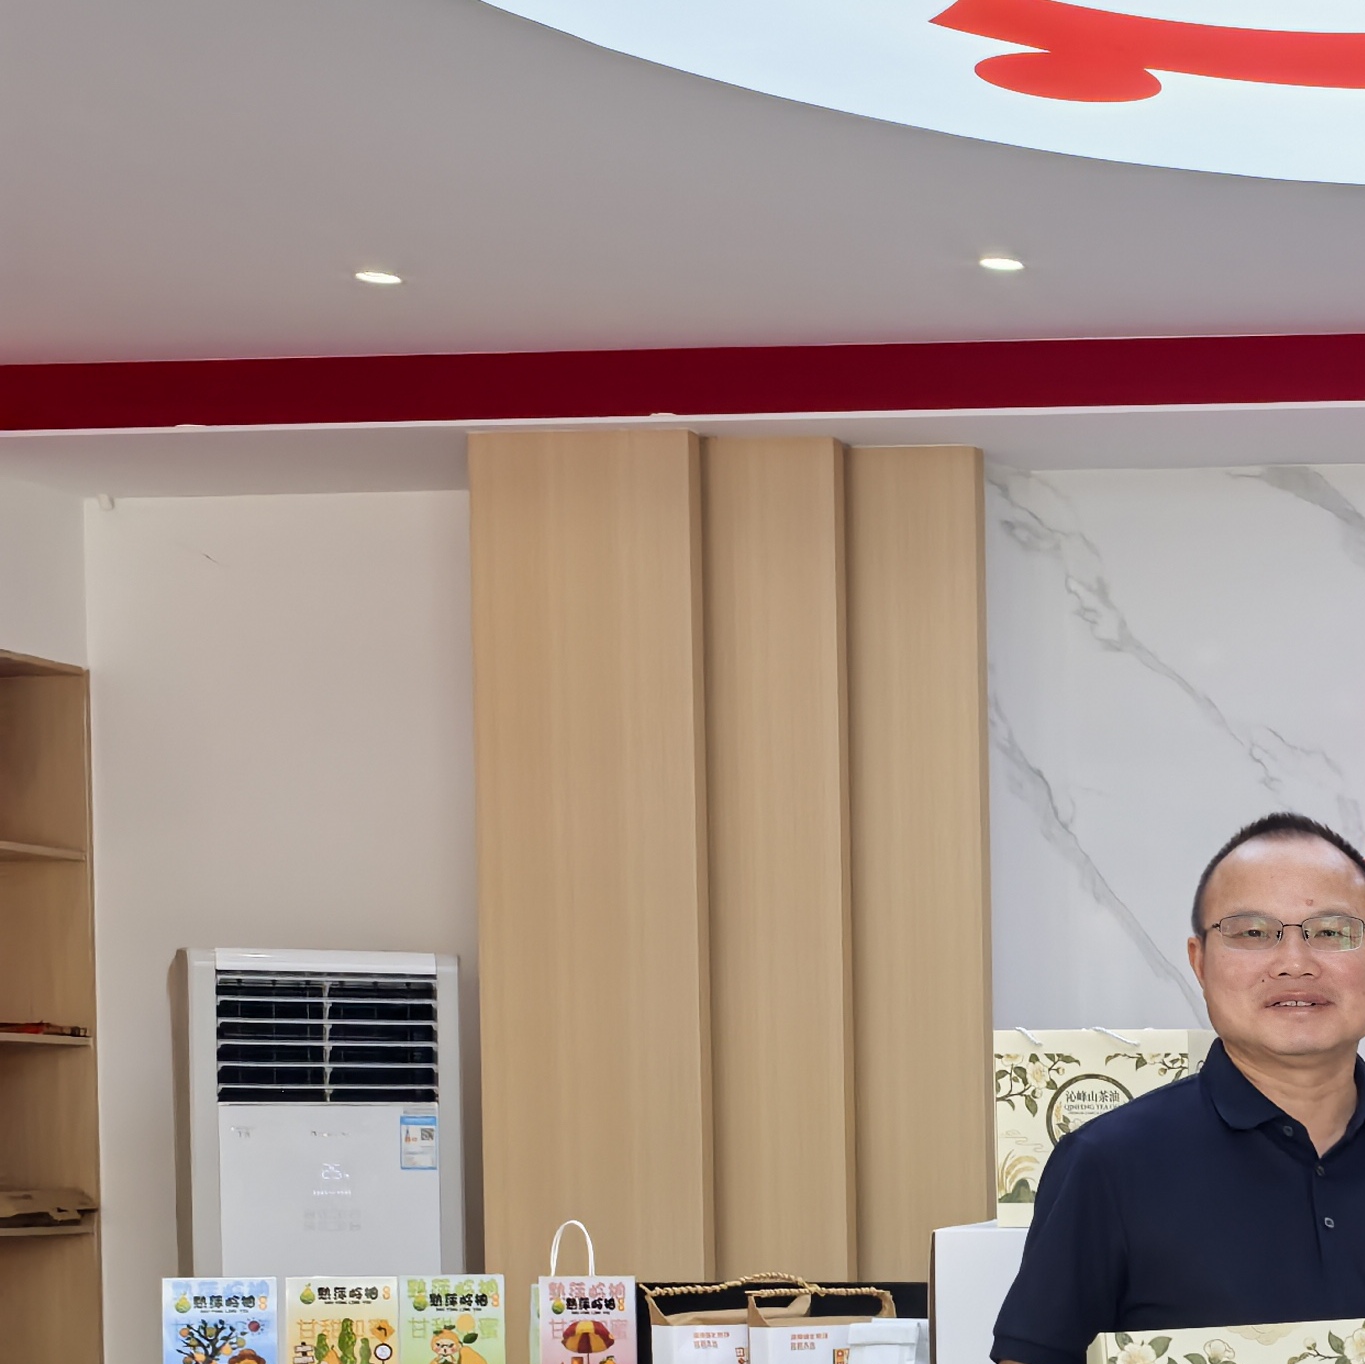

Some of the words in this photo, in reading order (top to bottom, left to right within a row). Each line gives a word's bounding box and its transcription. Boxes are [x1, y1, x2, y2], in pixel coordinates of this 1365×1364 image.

[1065, 1090, 1120, 1103] 沁峰山茶油
